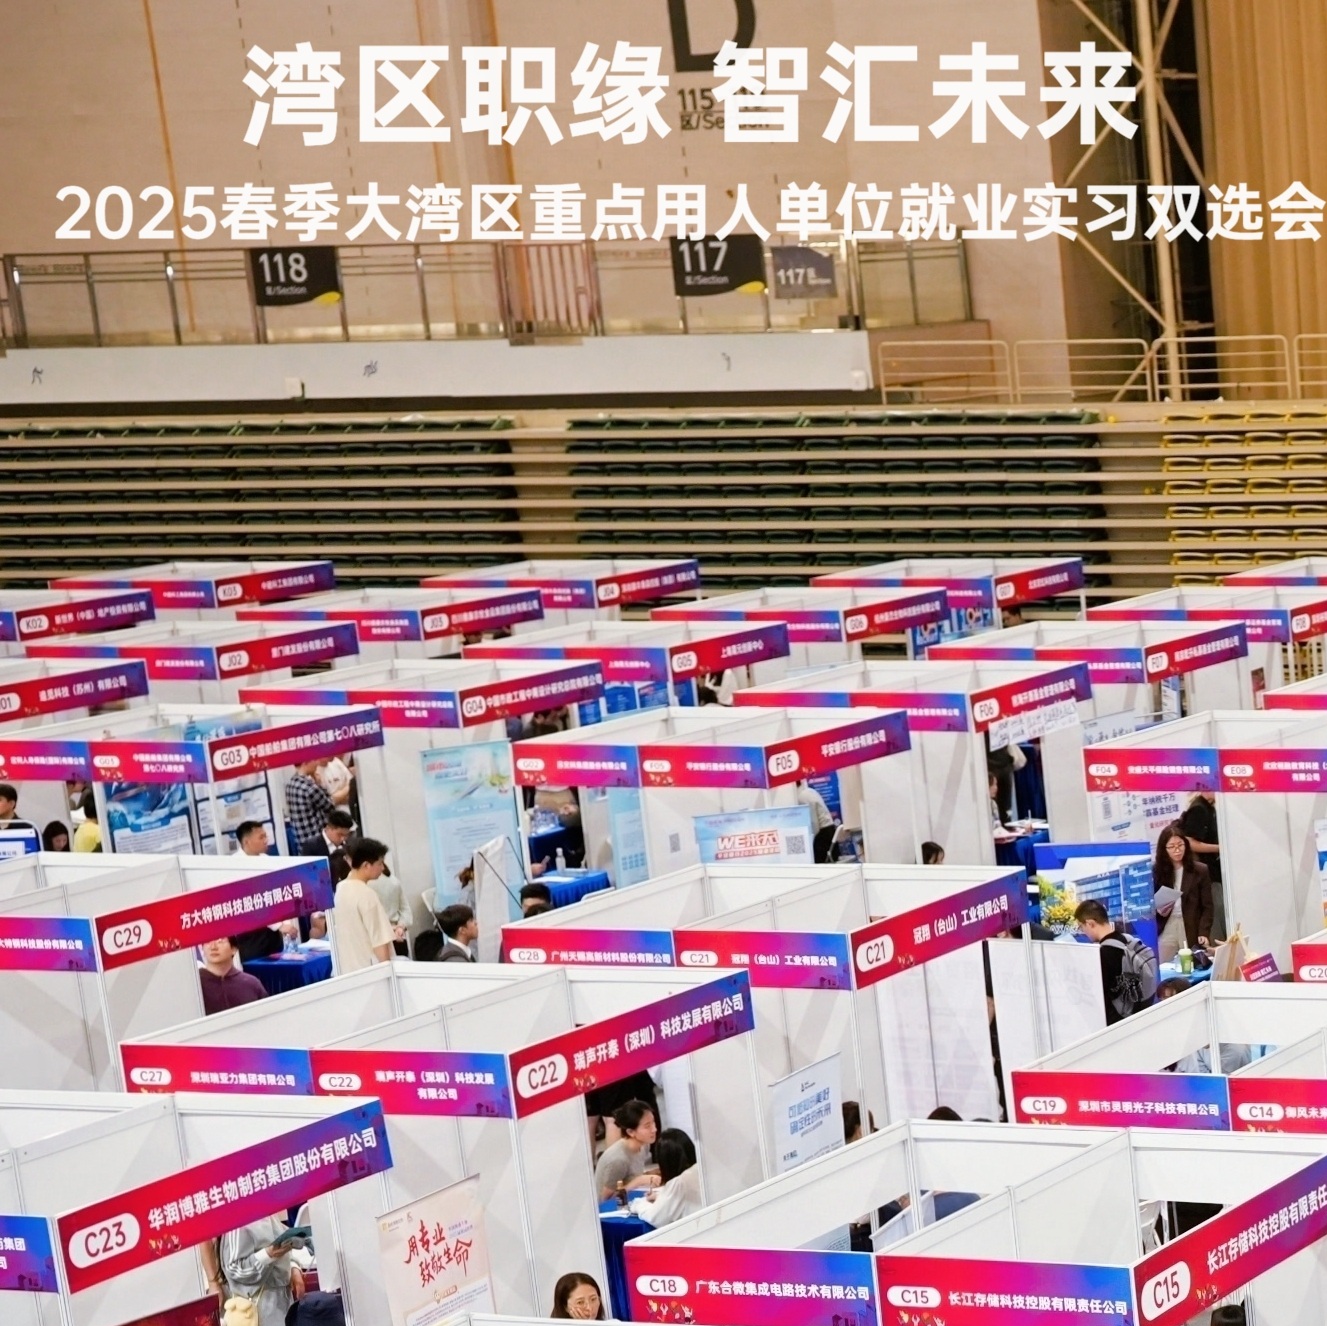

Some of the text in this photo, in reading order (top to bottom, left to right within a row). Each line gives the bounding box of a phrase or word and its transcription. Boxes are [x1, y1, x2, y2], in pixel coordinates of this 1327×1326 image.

[679, 242, 728, 270] 117
[258, 253, 307, 283] 118
[26, 617, 43, 630] K02
[227, 654, 242, 666] J02
[1151, 656, 1164, 670] F07
[464, 701, 484, 715] G04
[979, 703, 994, 717] F06
[221, 750, 243, 766] G03
[775, 731, 886, 770] F05 平安银行股份有限公司
[1095, 765, 1112, 775] F04
[1230, 766, 1247, 775] E08
[1292, 772, 1320, 782] 有限公司
[112, 882, 303, 949] C29 方大特钢科技股份有限公司
[864, 895, 1009, 966] C21 冠翔（台山）工业有限公司
[518, 949, 539, 961] C28
[689, 953, 837, 968] C21 冠翔（台山）工业有限公司
[527, 993, 744, 1089] C22 瑞声开泰（深圳）科技发展有限公司
[139, 1070, 164, 1083] C27
[328, 1070, 495, 1088] C22 瑞声开泰（深圳）科技发展
[416, 1087, 458, 1101] 有限公司
[1033, 1099, 1220, 1117] C19 深圳市灵明光子科技有限公司
[1249, 1105, 1273, 1118] C14
[83, 1127, 378, 1258] C23 华润博雅生物制药集团股份有限公司
[418, 1238, 473, 1289] 致敬生命
[649, 1277, 870, 1302] C18 广东合微集成电路技术有限公司
[1152, 1271, 1180, 1309] C15
[901, 1288, 1128, 1315] C15 长江存储科技控股有限责任公司
